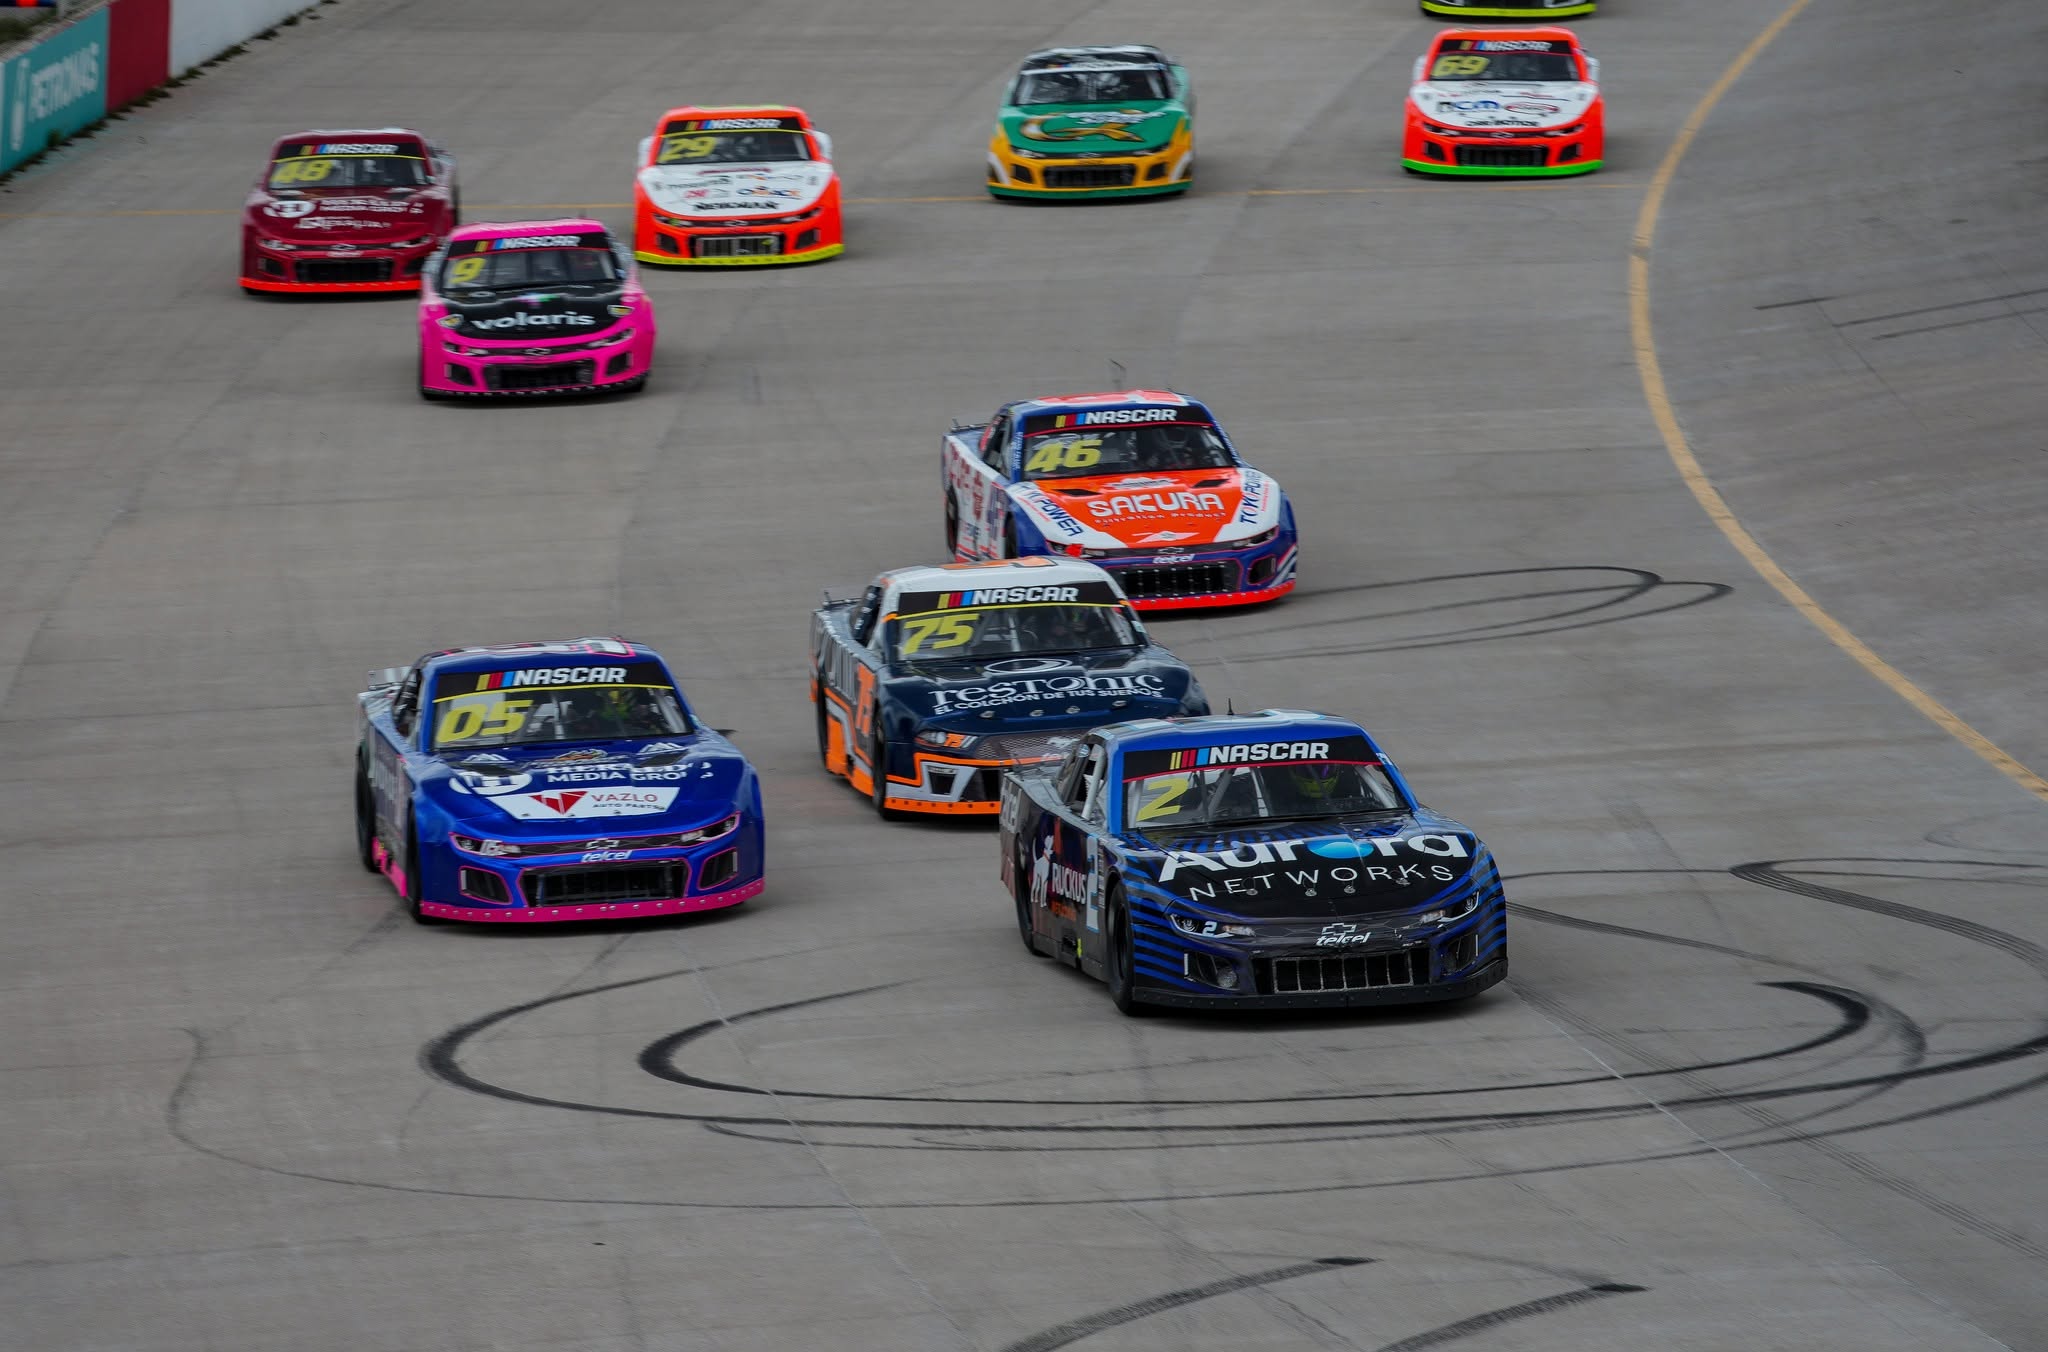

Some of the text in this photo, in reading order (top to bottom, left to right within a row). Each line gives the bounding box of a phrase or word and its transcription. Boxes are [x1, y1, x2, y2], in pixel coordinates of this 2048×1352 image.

[1483, 41, 1552, 51] NASCAR
[1430, 55, 1490, 76] 69
[711, 119, 781, 129] NASCAR
[327, 144, 399, 154] NASCAR
[657, 137, 717, 163] 29
[270, 160, 333, 183] 48
[503, 236, 581, 249] NASCAR
[452, 257, 487, 283] 9
[472, 311, 596, 330] volaris
[1086, 409, 1177, 425] NASCAR
[1025, 439, 1103, 472] 46
[1087, 492, 1225, 517] SAKURA
[1152, 554, 1195, 564] telcel
[973, 587, 1079, 605] NASCAR
[903, 613, 980, 655] 75
[513, 667, 627, 686] NASCAR
[933, 704, 954, 715] EL
[954, 692, 1040, 710] COLCHÓN
[1042, 690, 1066, 700] DE
[1068, 688, 1096, 697] TUS
[437, 700, 533, 743] 05
[1208, 743, 1329, 764] NASCAR
[547, 771, 627, 783] MEDIA
[591, 794, 658, 803] VAZLO
[1136, 779, 1190, 822] 2
[580, 850, 632, 863] telcel
[1051, 862, 1087, 905] RUCKUS
[1189, 863, 1455, 901] NETWORKS
[1202, 921, 1218, 935] 2
[1314, 931, 1372, 946] telcel
